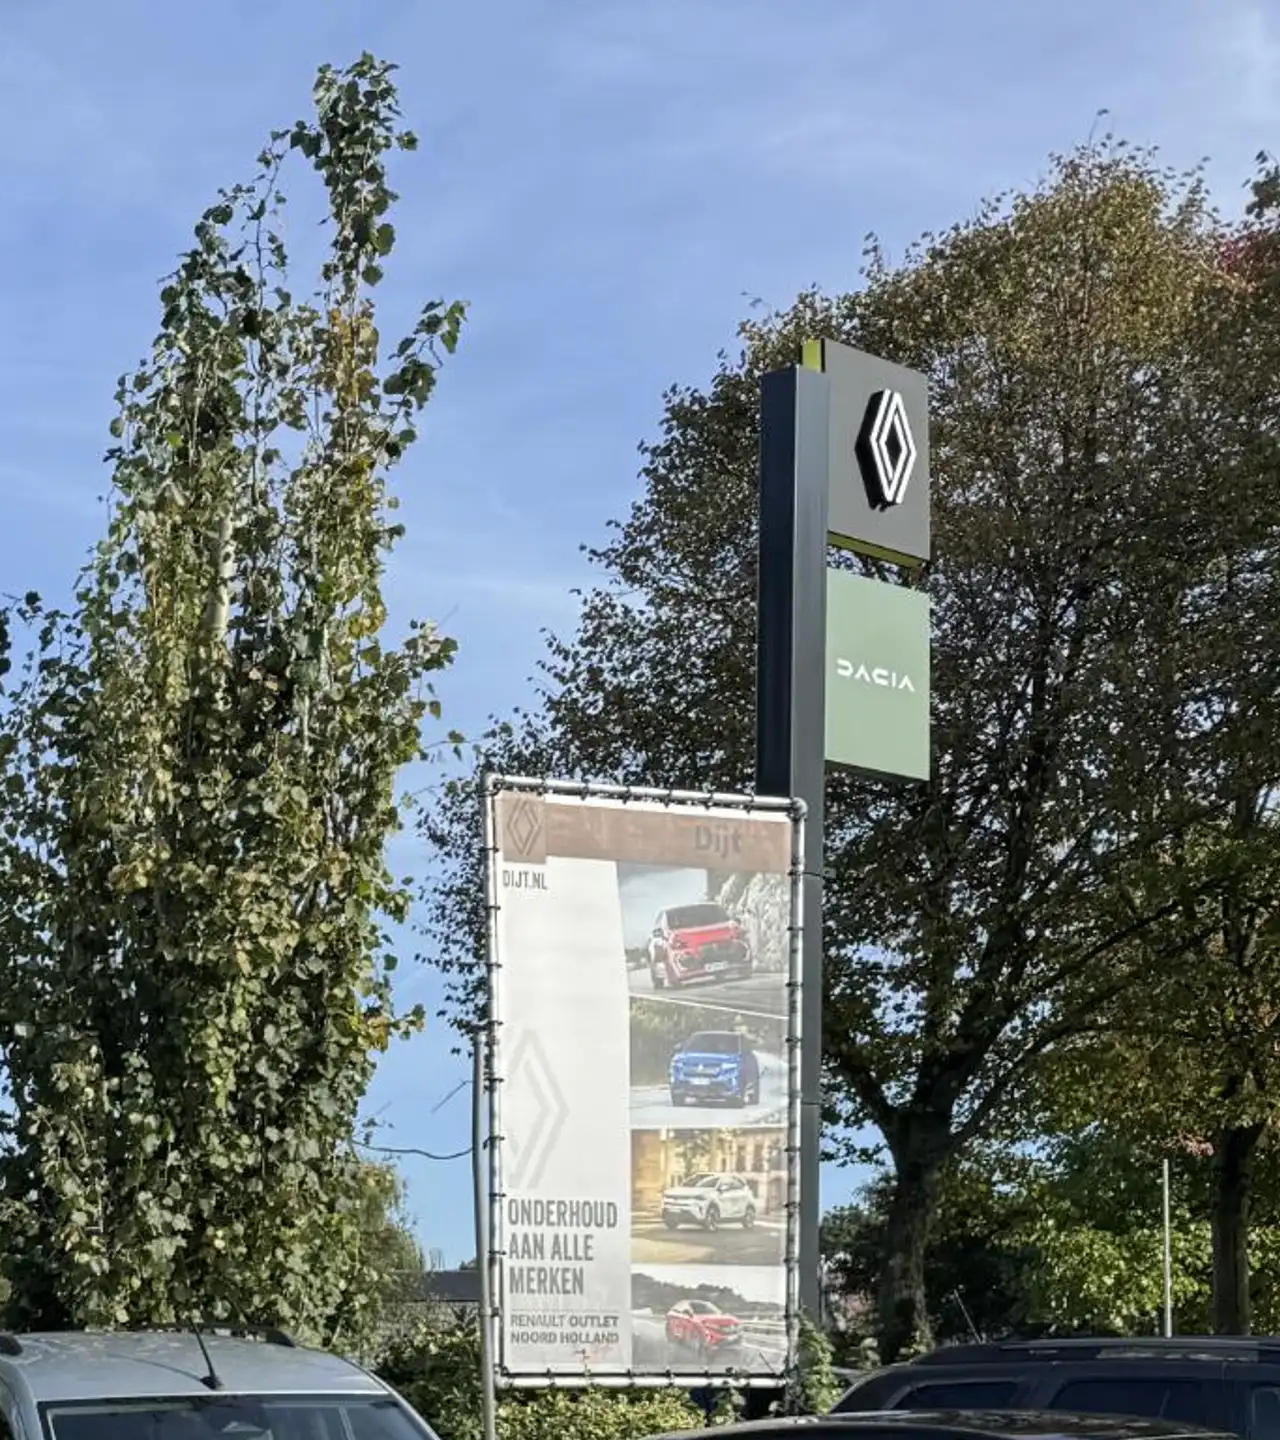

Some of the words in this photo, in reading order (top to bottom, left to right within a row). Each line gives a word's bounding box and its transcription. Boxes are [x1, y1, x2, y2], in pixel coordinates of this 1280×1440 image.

[837, 658, 915, 692] DACIA
[695, 824, 741, 859] Dijt
[502, 867, 548, 890] DIJT.NL
[508, 1198, 618, 1228] ONDERHOUD
[509, 1232, 545, 1261] AAN
[550, 1232, 594, 1262] ALLE
[509, 1266, 584, 1295] MERKEN
[511, 1314, 565, 1328] RENAULT
[568, 1316, 620, 1328] OUTLET
[511, 1331, 557, 1344] NOORD
[560, 1331, 619, 1345] HOLLAND
